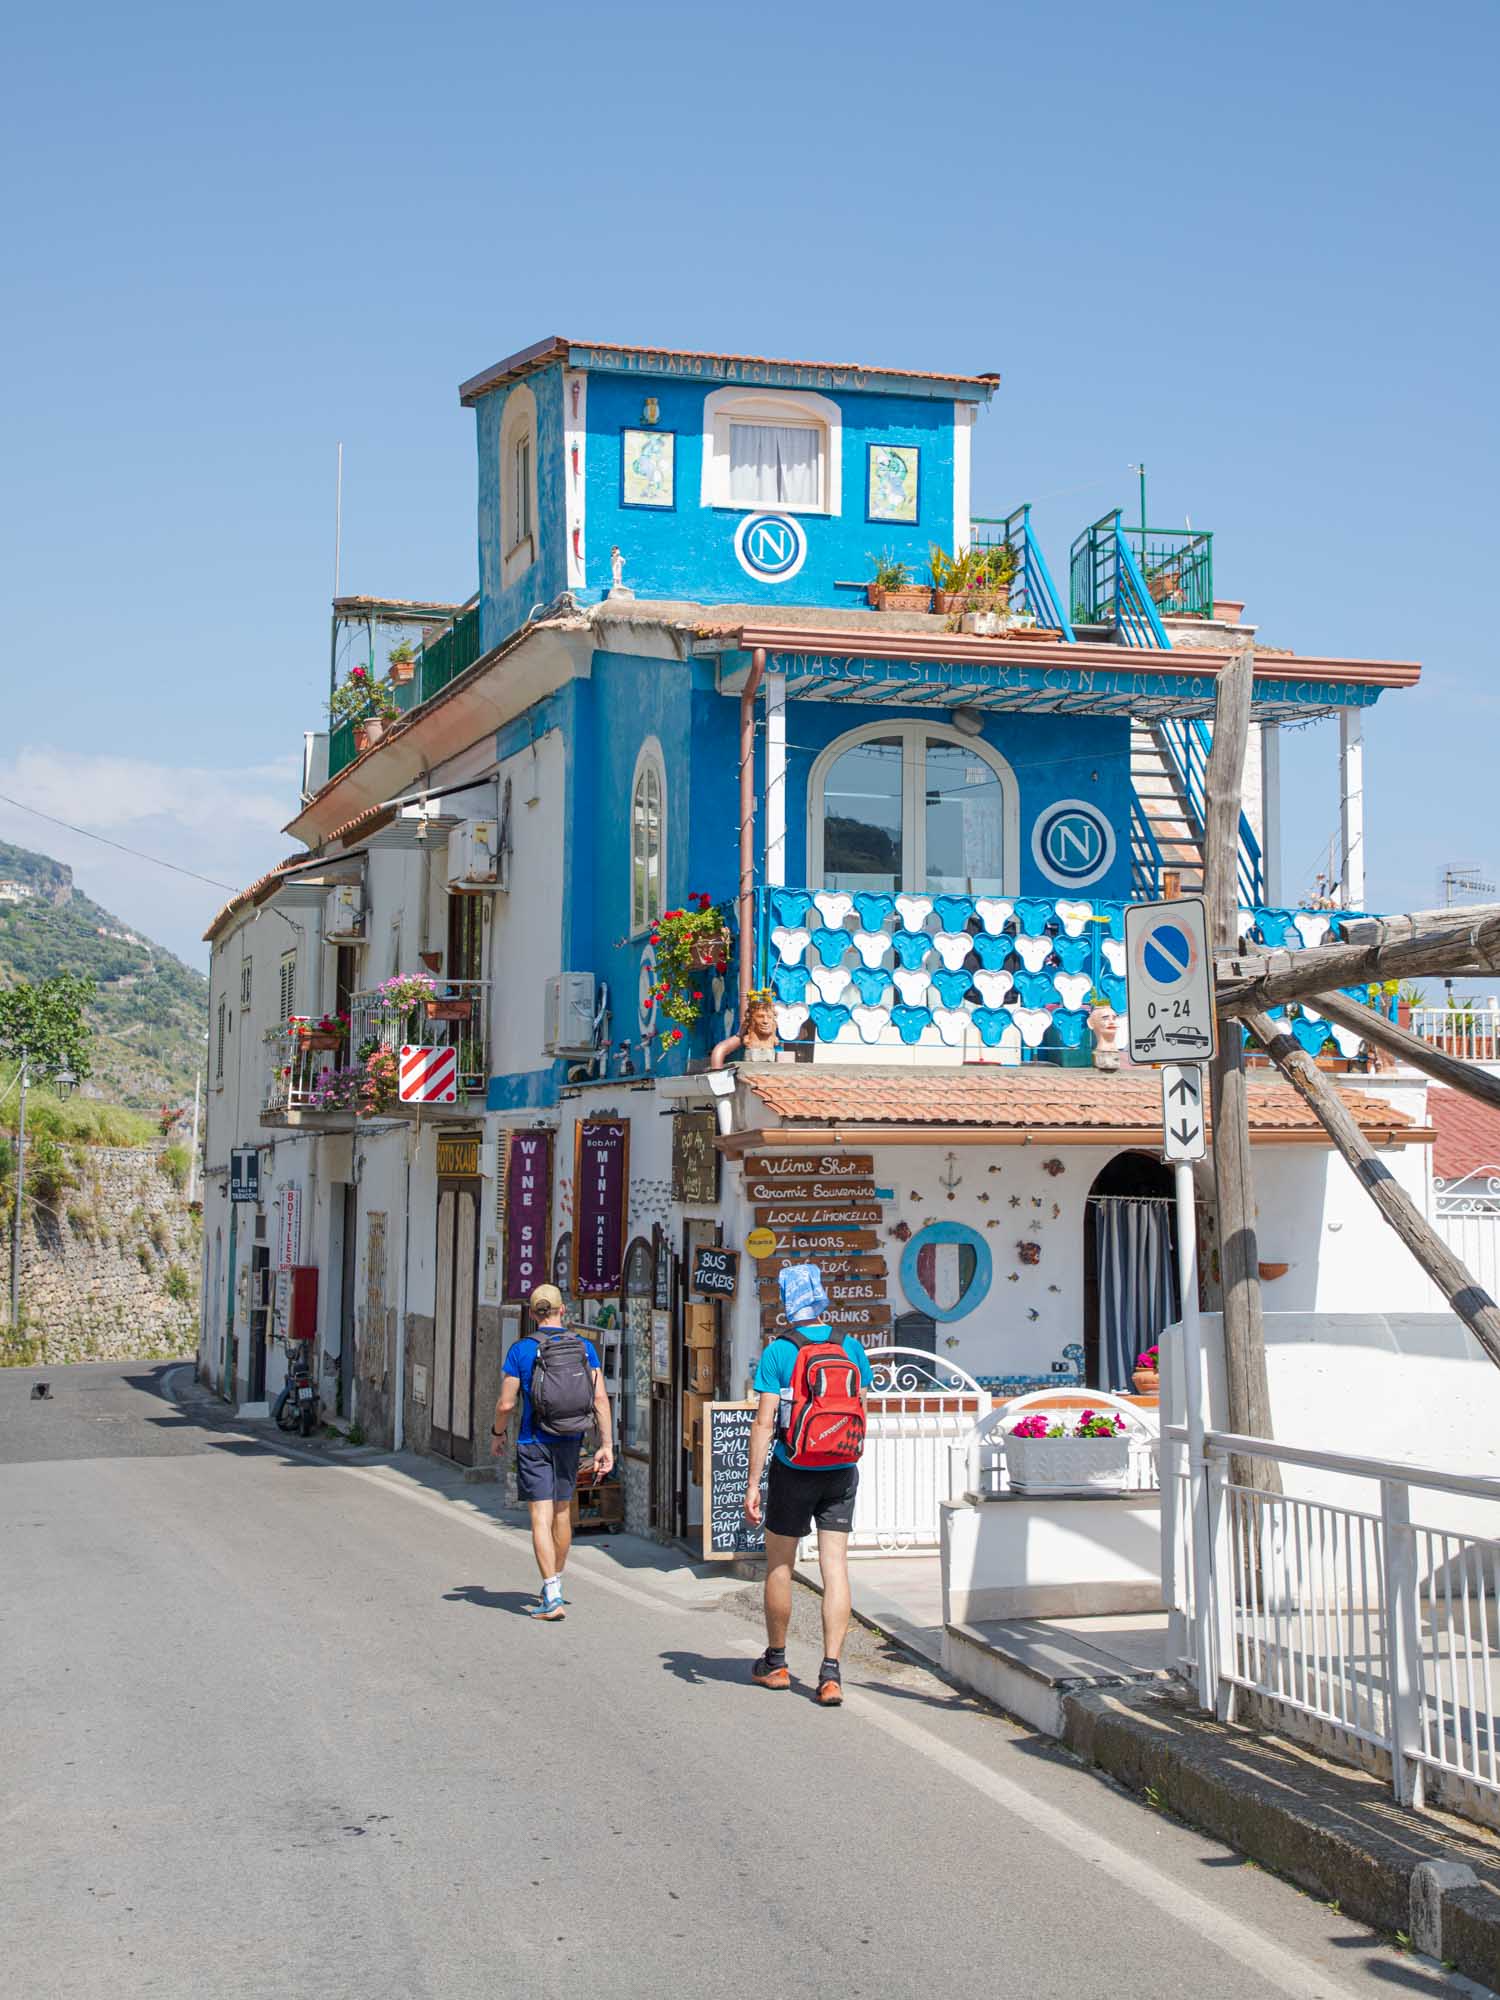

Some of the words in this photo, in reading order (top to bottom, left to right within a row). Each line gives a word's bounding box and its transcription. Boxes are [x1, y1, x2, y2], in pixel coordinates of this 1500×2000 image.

[756, 527, 786, 561] N
[793, 653, 875, 680] NASCE
[886, 660, 900, 681] E
[938, 663, 1030, 688] MUORE
[1044, 669, 1094, 692] CON
[1132, 674, 1216, 697] NAPO
[1295, 682, 1376, 705] CUORE
[1057, 825, 1091, 862] N
[520, 1141, 537, 1206] WINE
[597, 1150, 608, 1206] MINI
[761, 1158, 815, 1174] Wine
[753, 1184, 808, 1199] Ceramic
[285, 1192, 293, 1264] BOTTLES
[767, 1210, 809, 1223] LOCAL
[596, 1215, 605, 1277] MARKET
[520, 1226, 533, 1293] SHOP
[702, 1251, 727, 1270] BUS
[712, 1410, 755, 1425] MINERAL
[712, 1439, 749, 1454] SMAL
[712, 1520, 740, 1533] FANTA
[712, 1533, 736, 1548] TEA
